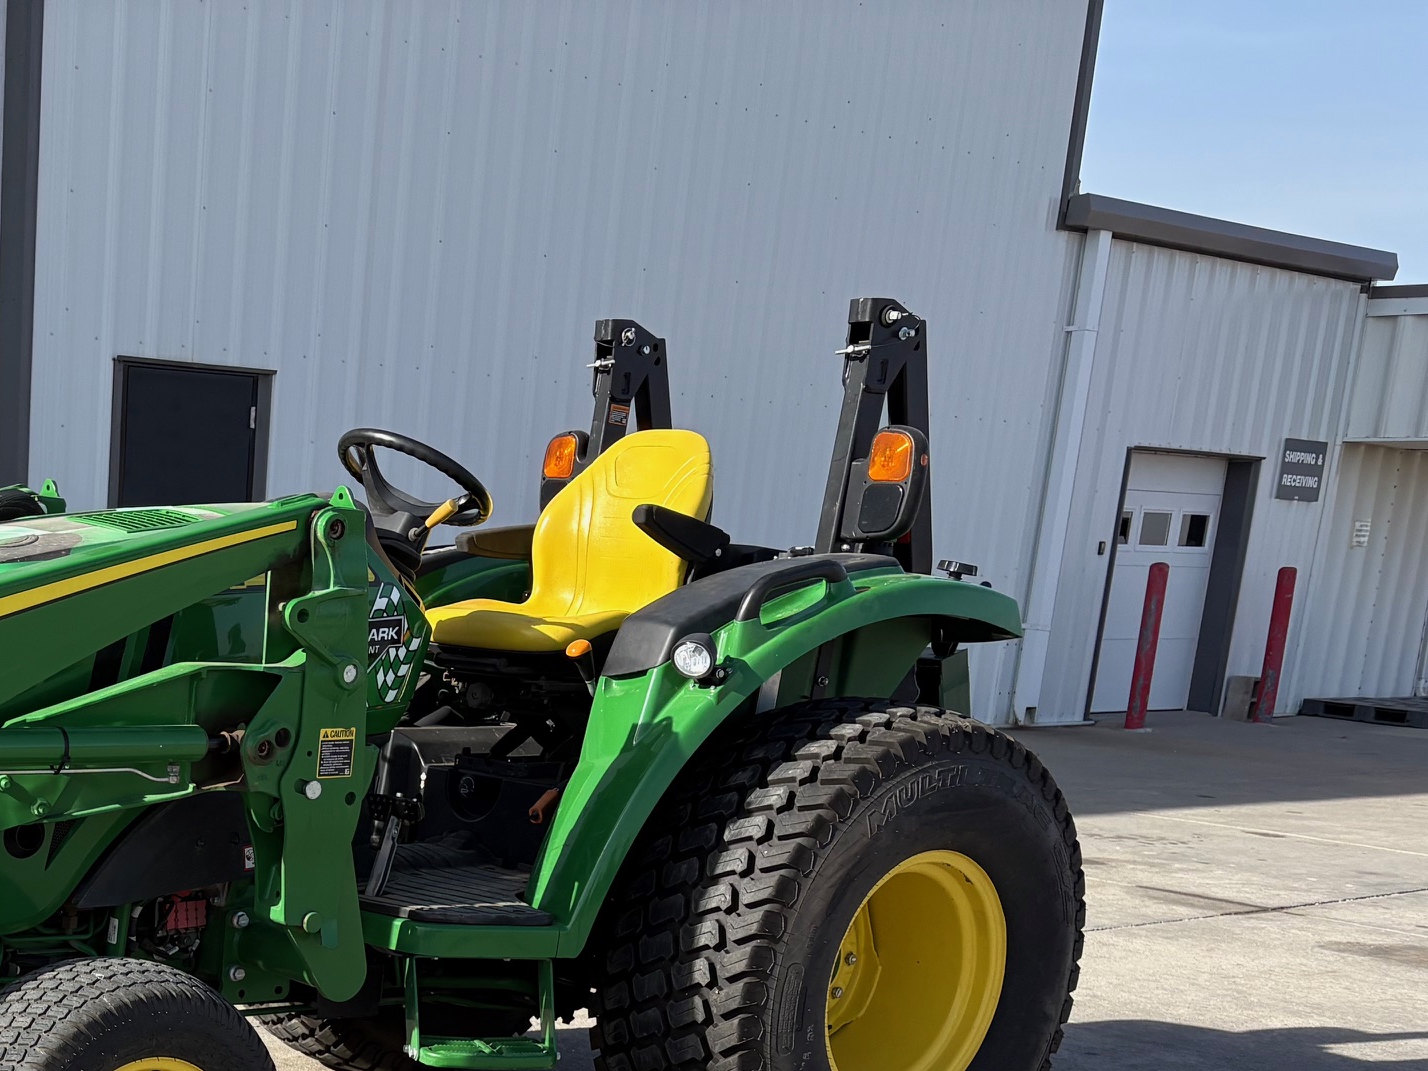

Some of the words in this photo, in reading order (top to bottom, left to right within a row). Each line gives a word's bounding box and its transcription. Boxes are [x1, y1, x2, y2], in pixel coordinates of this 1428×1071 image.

[1284, 450, 1316, 465] SHIPPING
[1317, 454, 1323, 465] &
[1281, 474, 1318, 488] RECEIVING
[329, 729, 355, 739] CAUTION
